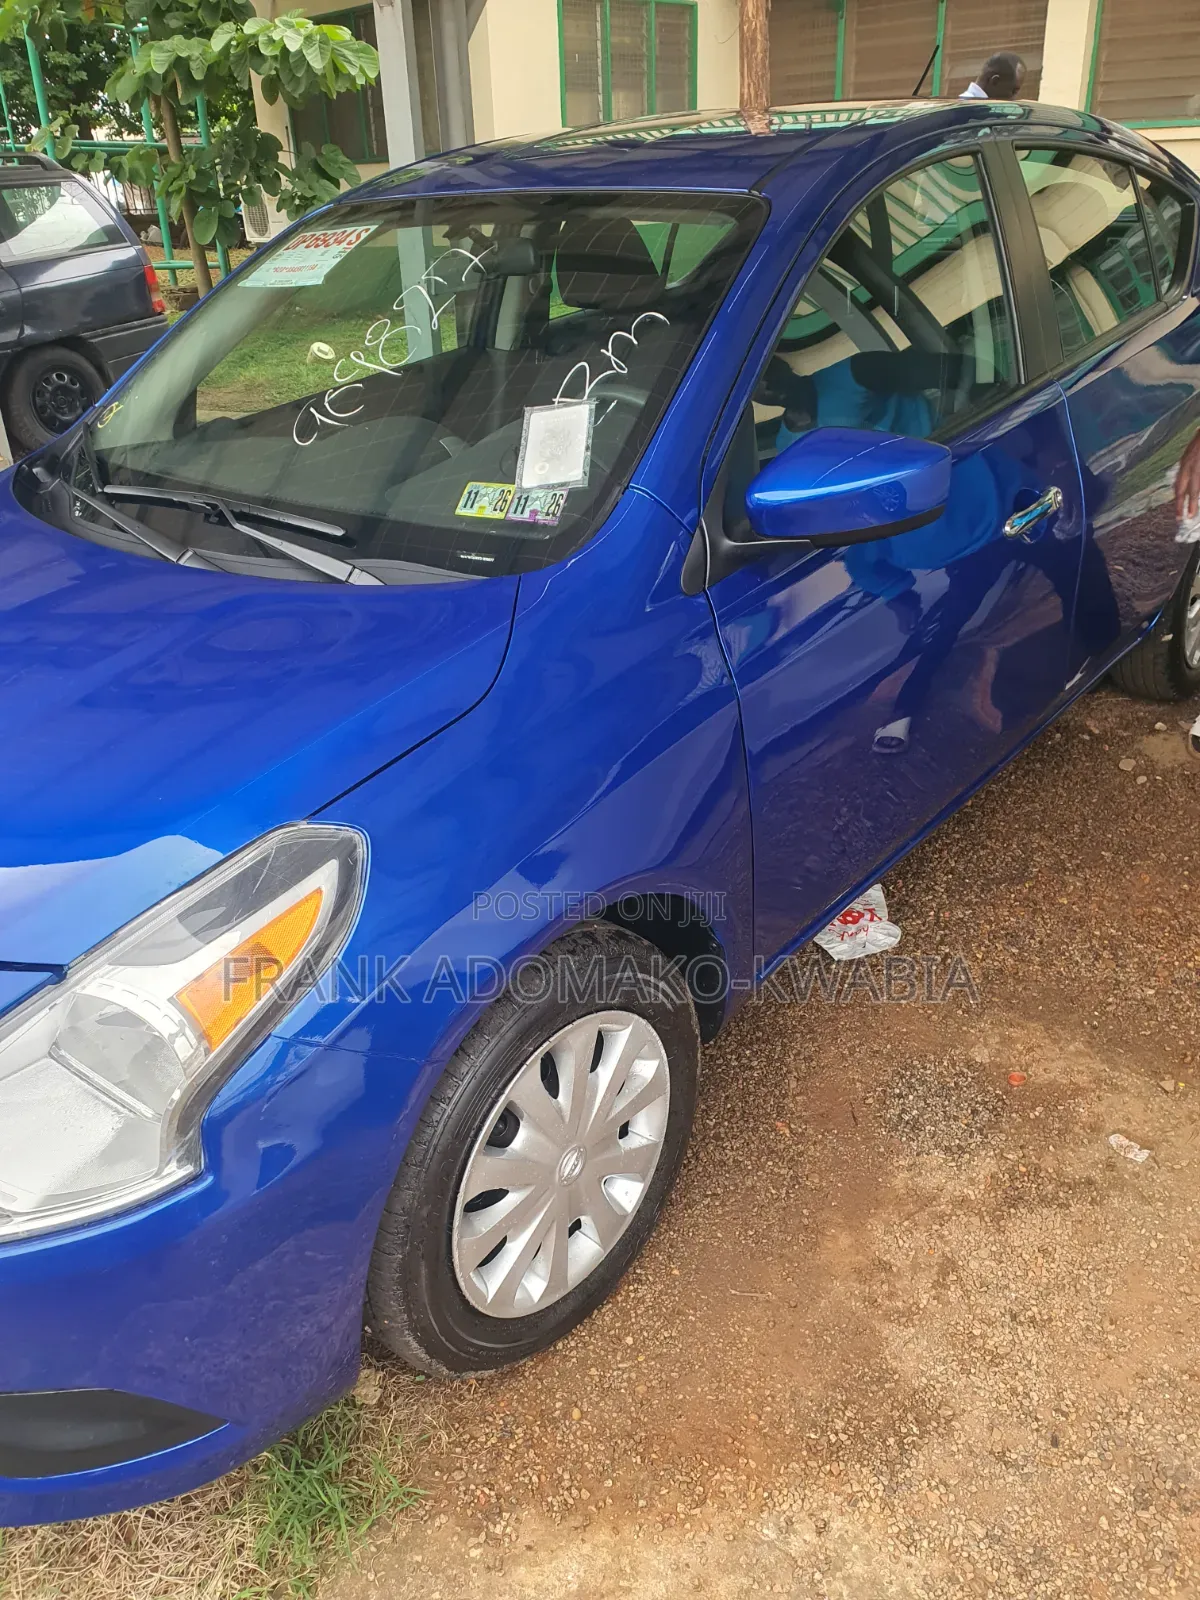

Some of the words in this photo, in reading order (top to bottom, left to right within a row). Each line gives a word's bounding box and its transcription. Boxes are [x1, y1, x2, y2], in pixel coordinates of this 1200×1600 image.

[463, 489, 480, 509] 11
[493, 489, 511, 513] 26
[513, 494, 530, 515] 11
[545, 492, 564, 517] 26
